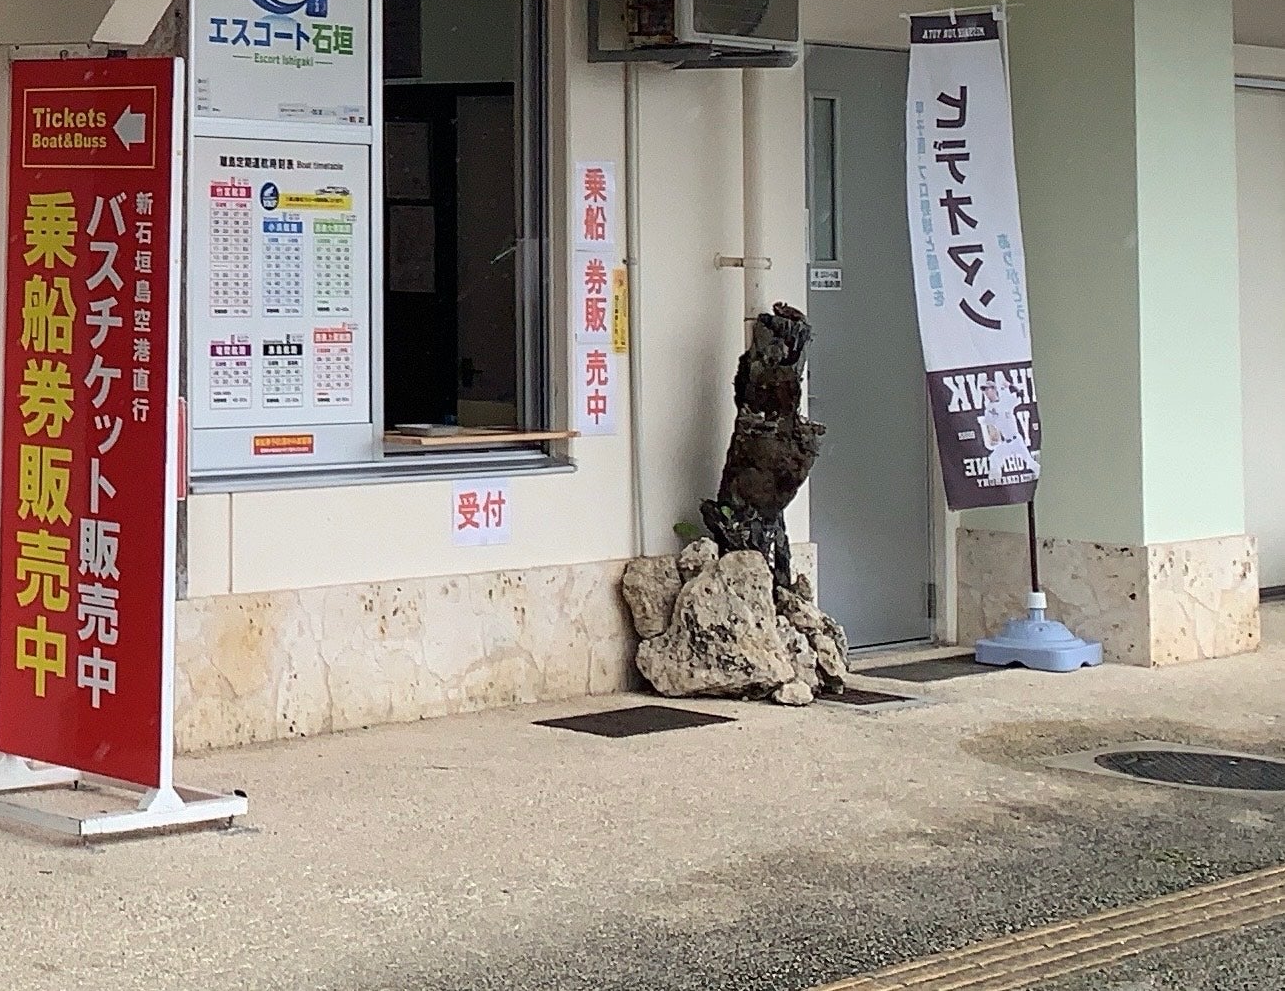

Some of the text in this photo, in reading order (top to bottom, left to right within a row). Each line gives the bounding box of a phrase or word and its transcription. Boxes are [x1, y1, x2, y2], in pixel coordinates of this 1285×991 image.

[209, 17, 354, 56] エスコート石垣
[254, 53, 314, 68] Escort Ishigaki
[32, 107, 107, 129] Tickets
[32, 133, 107, 149] Boat&Buss
[132, 192, 153, 422] 新石垣島空港直行
[584, 168, 609, 425] 乗船券販売中
[16, 192, 78, 698] 乗船券販売中
[76, 192, 127, 710] バスチケット販売中
[457, 490, 506, 530] 受付
